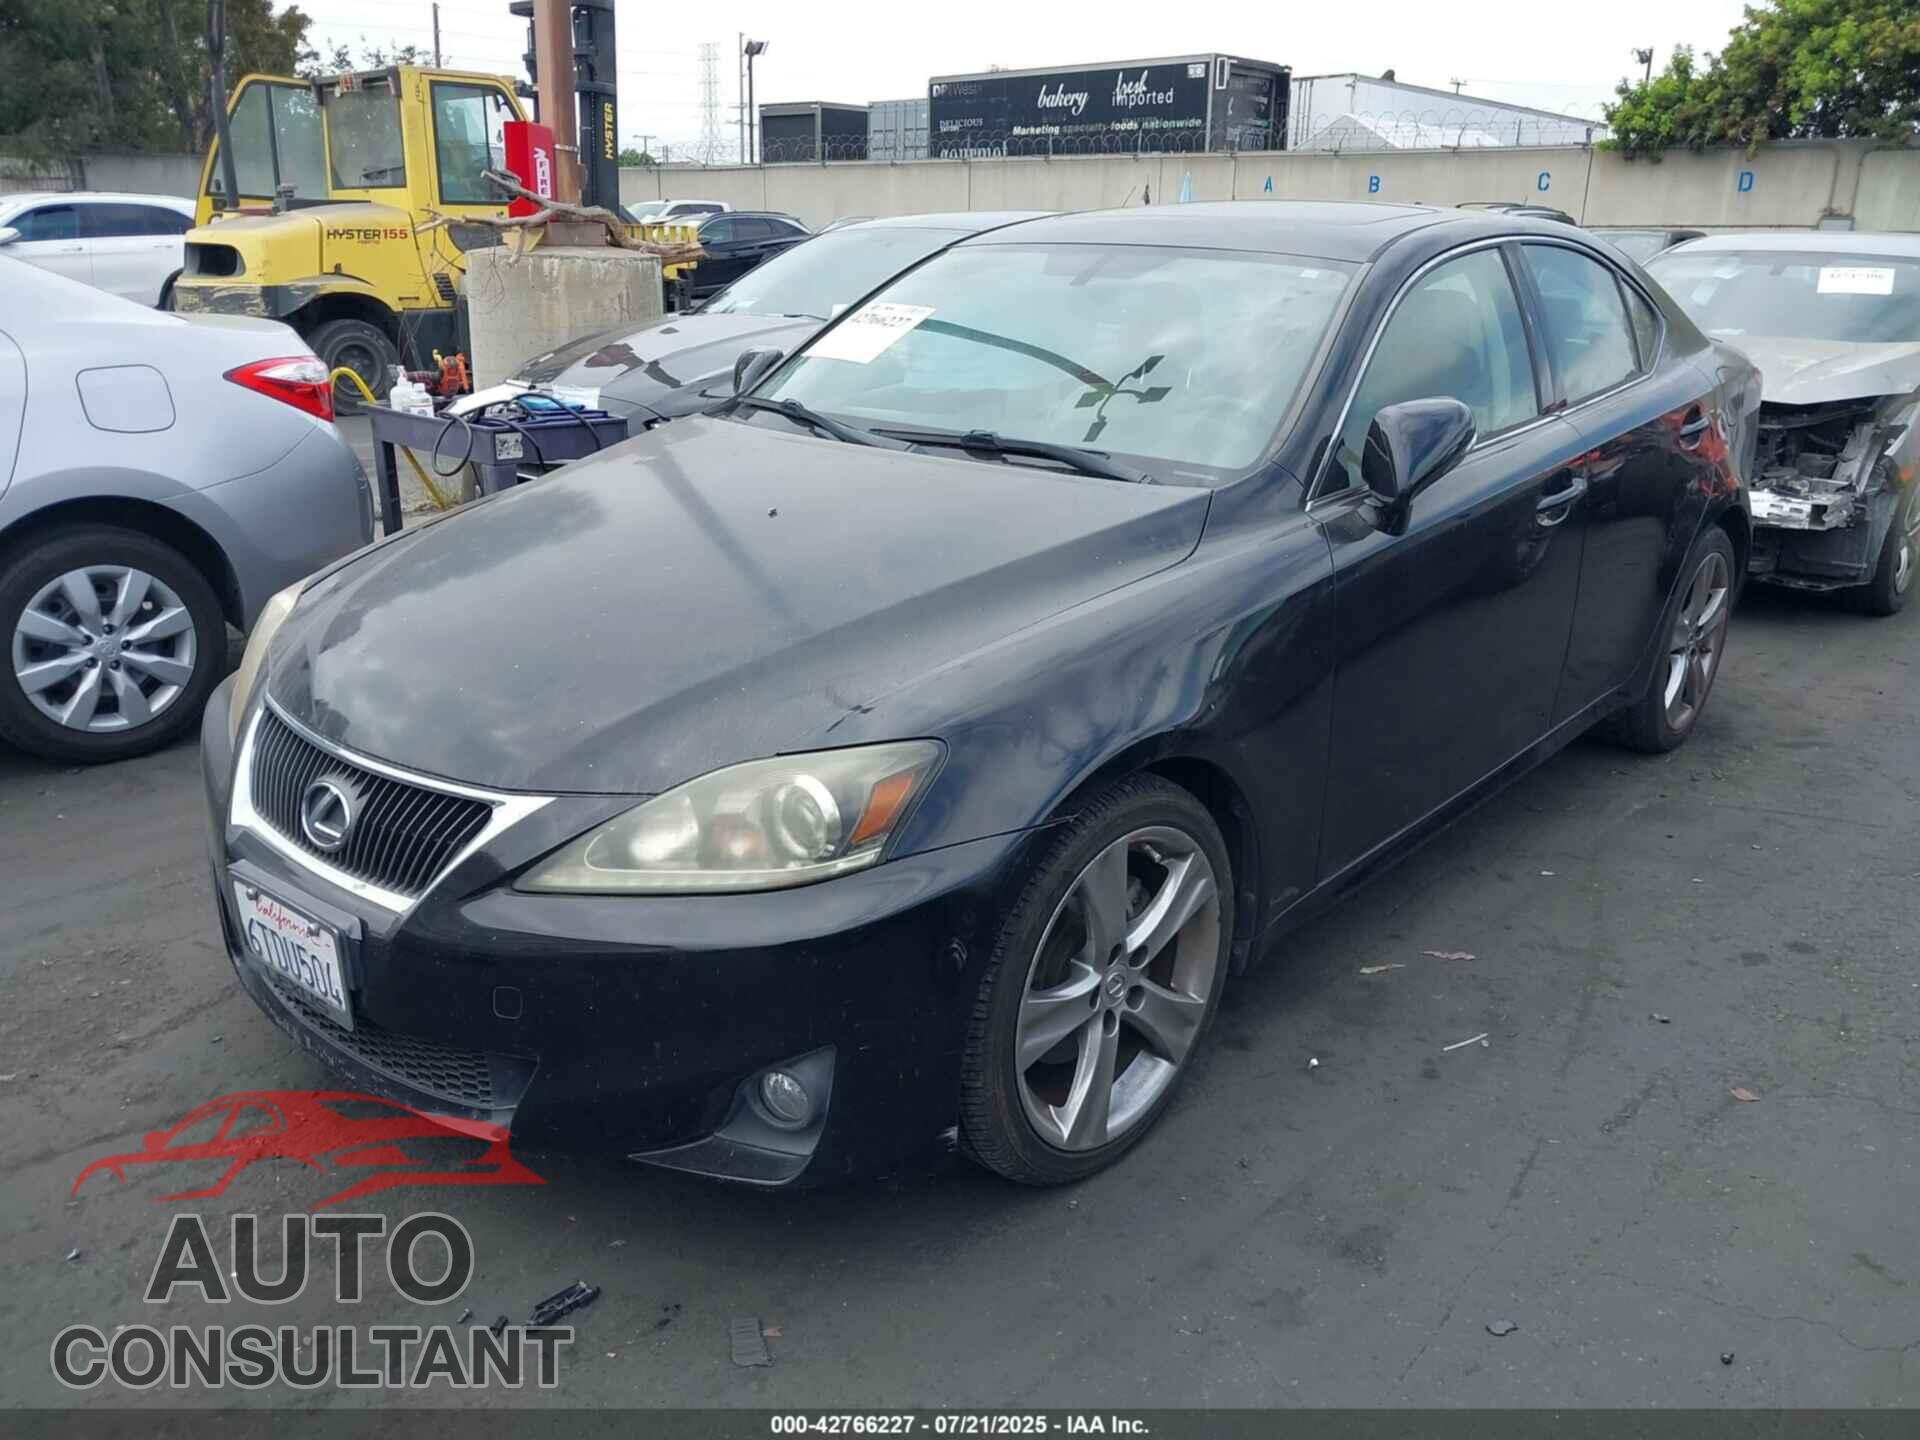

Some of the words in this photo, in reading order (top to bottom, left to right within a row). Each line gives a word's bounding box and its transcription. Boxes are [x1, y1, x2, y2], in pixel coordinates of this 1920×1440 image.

[1038, 83, 1088, 116] bakery
[1112, 88, 1174, 109] imported
[603, 102, 613, 160] HYSTER
[1012, 125, 1060, 137] Marketing
[1111, 119, 1138, 131] foods
[1141, 117, 1202, 129] nationwide
[539, 160, 549, 195] FIRE
[1263, 175, 1273, 193] A
[1368, 175, 1381, 193] B
[1536, 171, 1551, 192] C
[1737, 171, 1755, 192] D
[327, 228, 381, 240] HYSTER
[382, 228, 408, 240] 155
